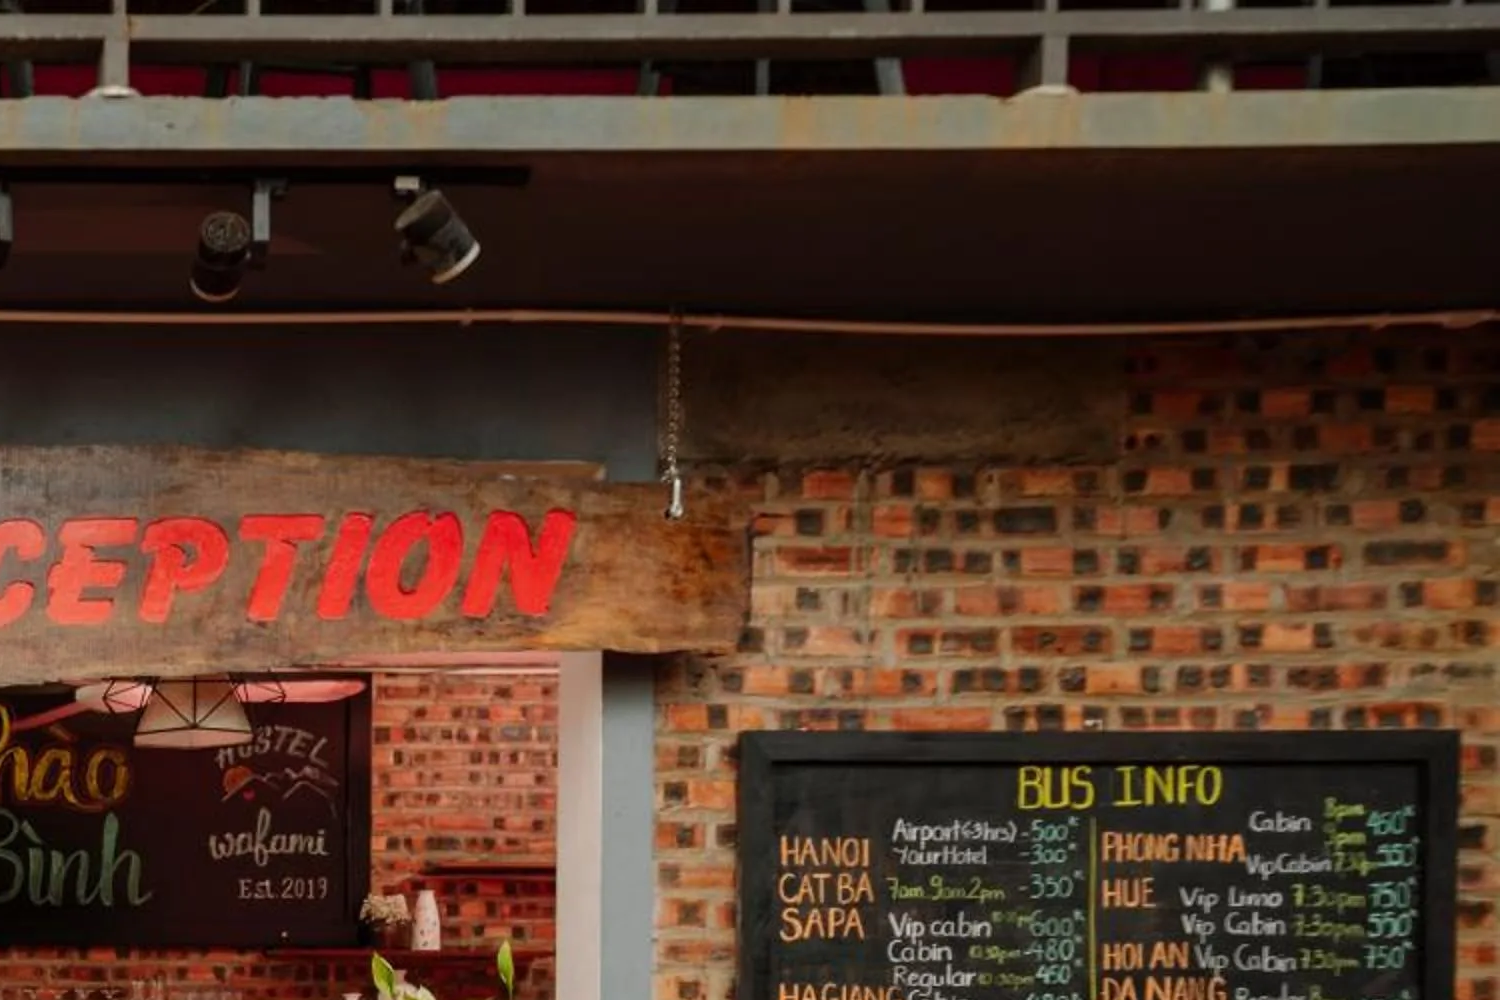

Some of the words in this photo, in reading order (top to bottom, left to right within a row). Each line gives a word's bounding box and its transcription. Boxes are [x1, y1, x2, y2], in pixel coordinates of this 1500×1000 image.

[1017, 764, 1095, 811] BUS
[1112, 765, 1222, 808] INFO
[208, 807, 329, 868] wafami
[1249, 811, 1311, 832] Cabin
[780, 836, 870, 866] HANOI
[1102, 832, 1180, 863] PHONG
[1184, 834, 1247, 864] NHA
[779, 873, 833, 903] CAT
[837, 873, 875, 904] BA
[1102, 876, 1156, 908] HUE
[1179, 886, 1220, 914] Vip
[1228, 885, 1284, 908] Limo
[780, 908, 866, 942] SAPA
[888, 912, 925, 945] Vip
[1182, 912, 1217, 944] Vip
[1223, 911, 1287, 936] Cabin
[887, 938, 953, 963] Cabin
[1102, 943, 1143, 971] HOI
[1149, 942, 1190, 969] AN
[1193, 944, 1230, 977] Vip
[1233, 943, 1298, 973] Cabin
[893, 964, 976, 995] Regular
